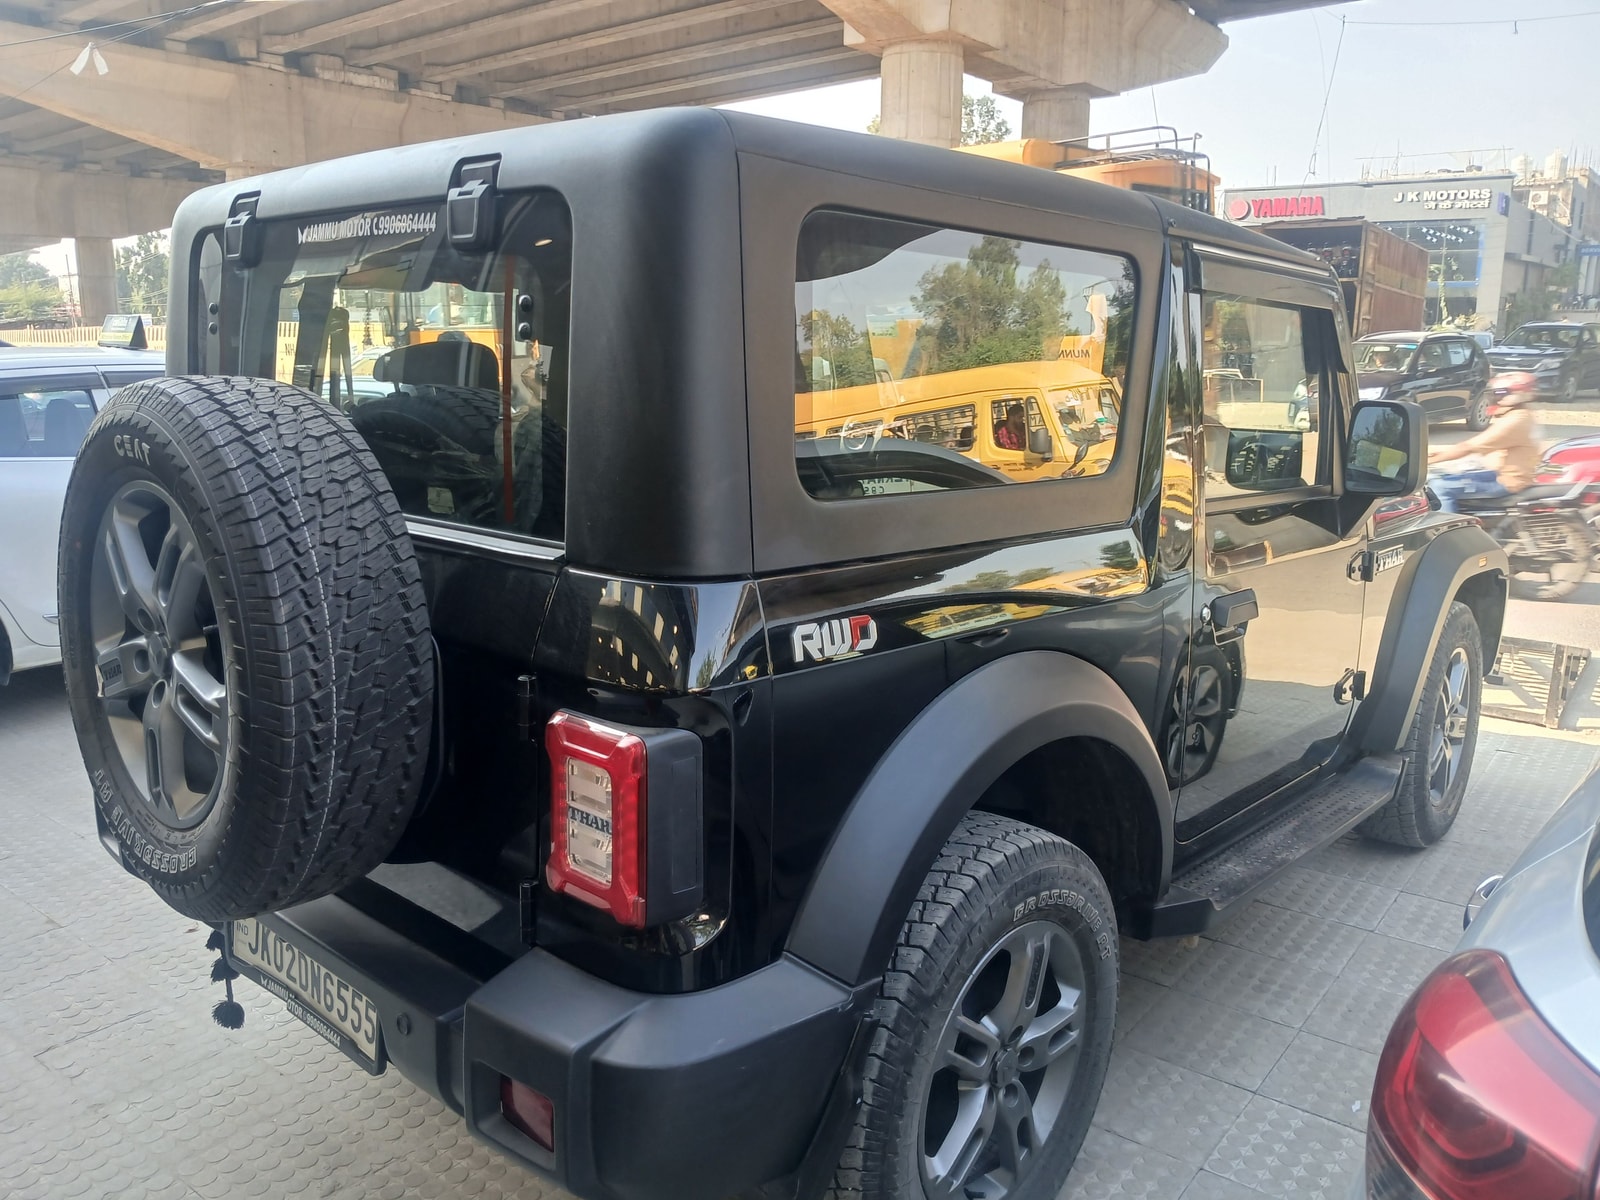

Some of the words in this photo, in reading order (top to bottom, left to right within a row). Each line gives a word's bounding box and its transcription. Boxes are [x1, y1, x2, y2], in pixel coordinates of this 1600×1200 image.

[1252, 196, 1324, 218] YAMAHA
[1393, 192, 1403, 202] J
[1408, 191, 1420, 202] K
[1423, 188, 1492, 201] MOTORS
[307, 220, 340, 241] JAMMU
[340, 217, 370, 237] MOTOR
[113, 434, 151, 467] CEAT
[793, 614, 878, 662] RWD
[569, 805, 612, 835] THAR
[111, 804, 197, 874] CROSSDRIVE
[1013, 888, 1102, 933] CROSSDRIVE
[236, 920, 249, 936] IND
[248, 920, 377, 1045] JK02DN6555
[266, 979, 289, 1001] JAMMU
